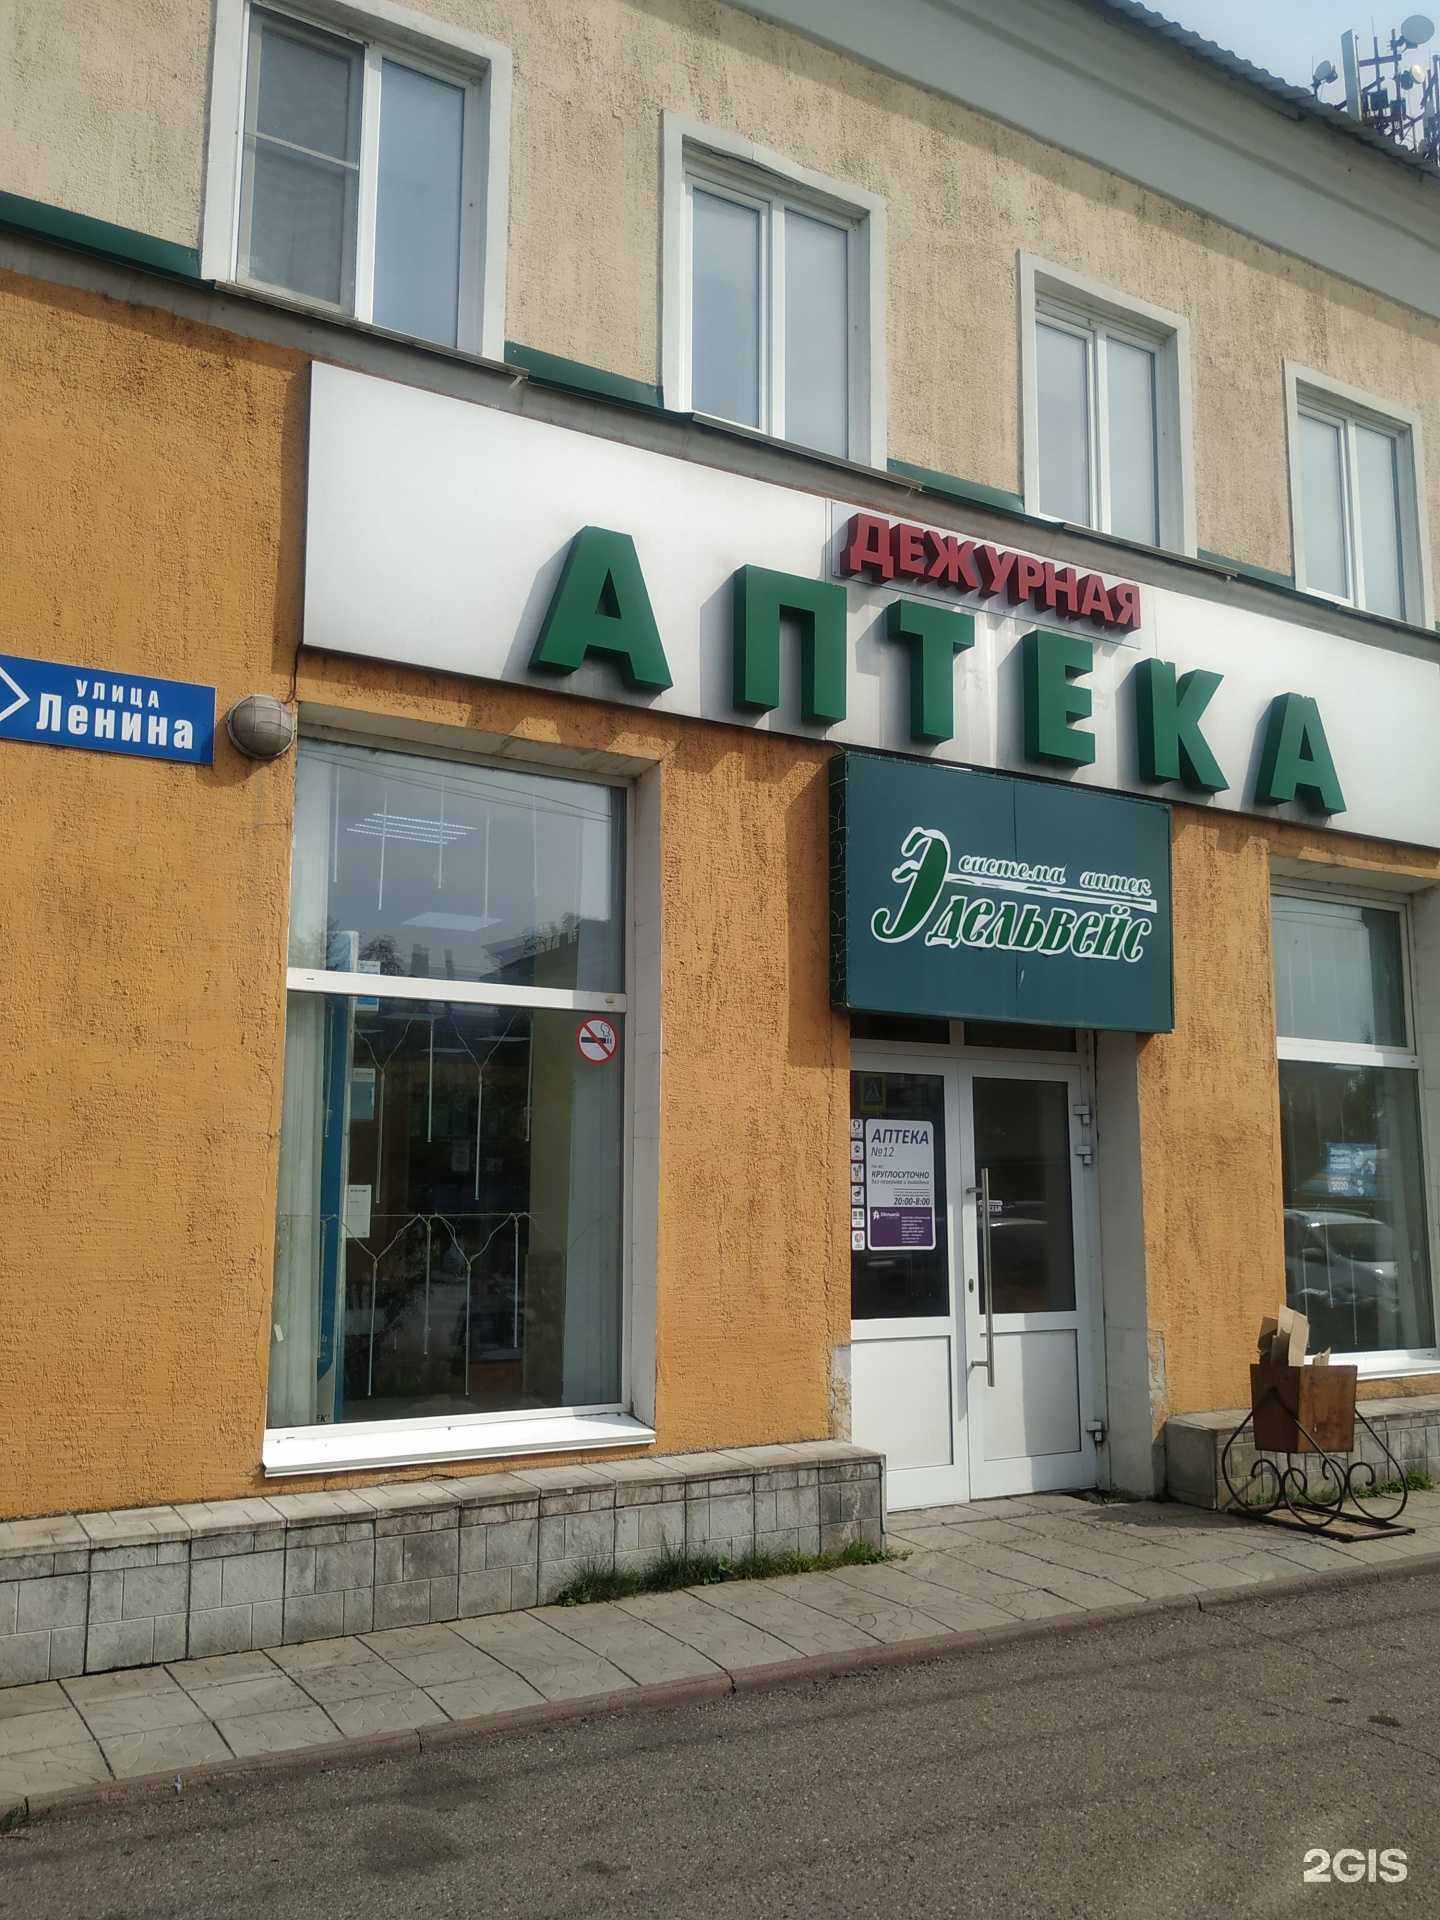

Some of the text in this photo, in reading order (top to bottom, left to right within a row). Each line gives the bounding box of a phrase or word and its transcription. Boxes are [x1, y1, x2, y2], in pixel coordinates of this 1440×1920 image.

[840, 513, 1141, 632] ДЕЖУРНАЯ
[527, 525, 1346, 814] АПТЕКА
[76, 679, 160, 708] УЛИЦА
[36, 693, 193, 749] Ленина
[871, 826, 1152, 962] Эдельвейс
[958, 854, 1152, 896] система аптек
[871, 1129, 929, 1144] АПТЕКА
[871, 1146, 895, 1157] №12
[871, 1170, 930, 1179] КРУГЛОСУТОЧНО
